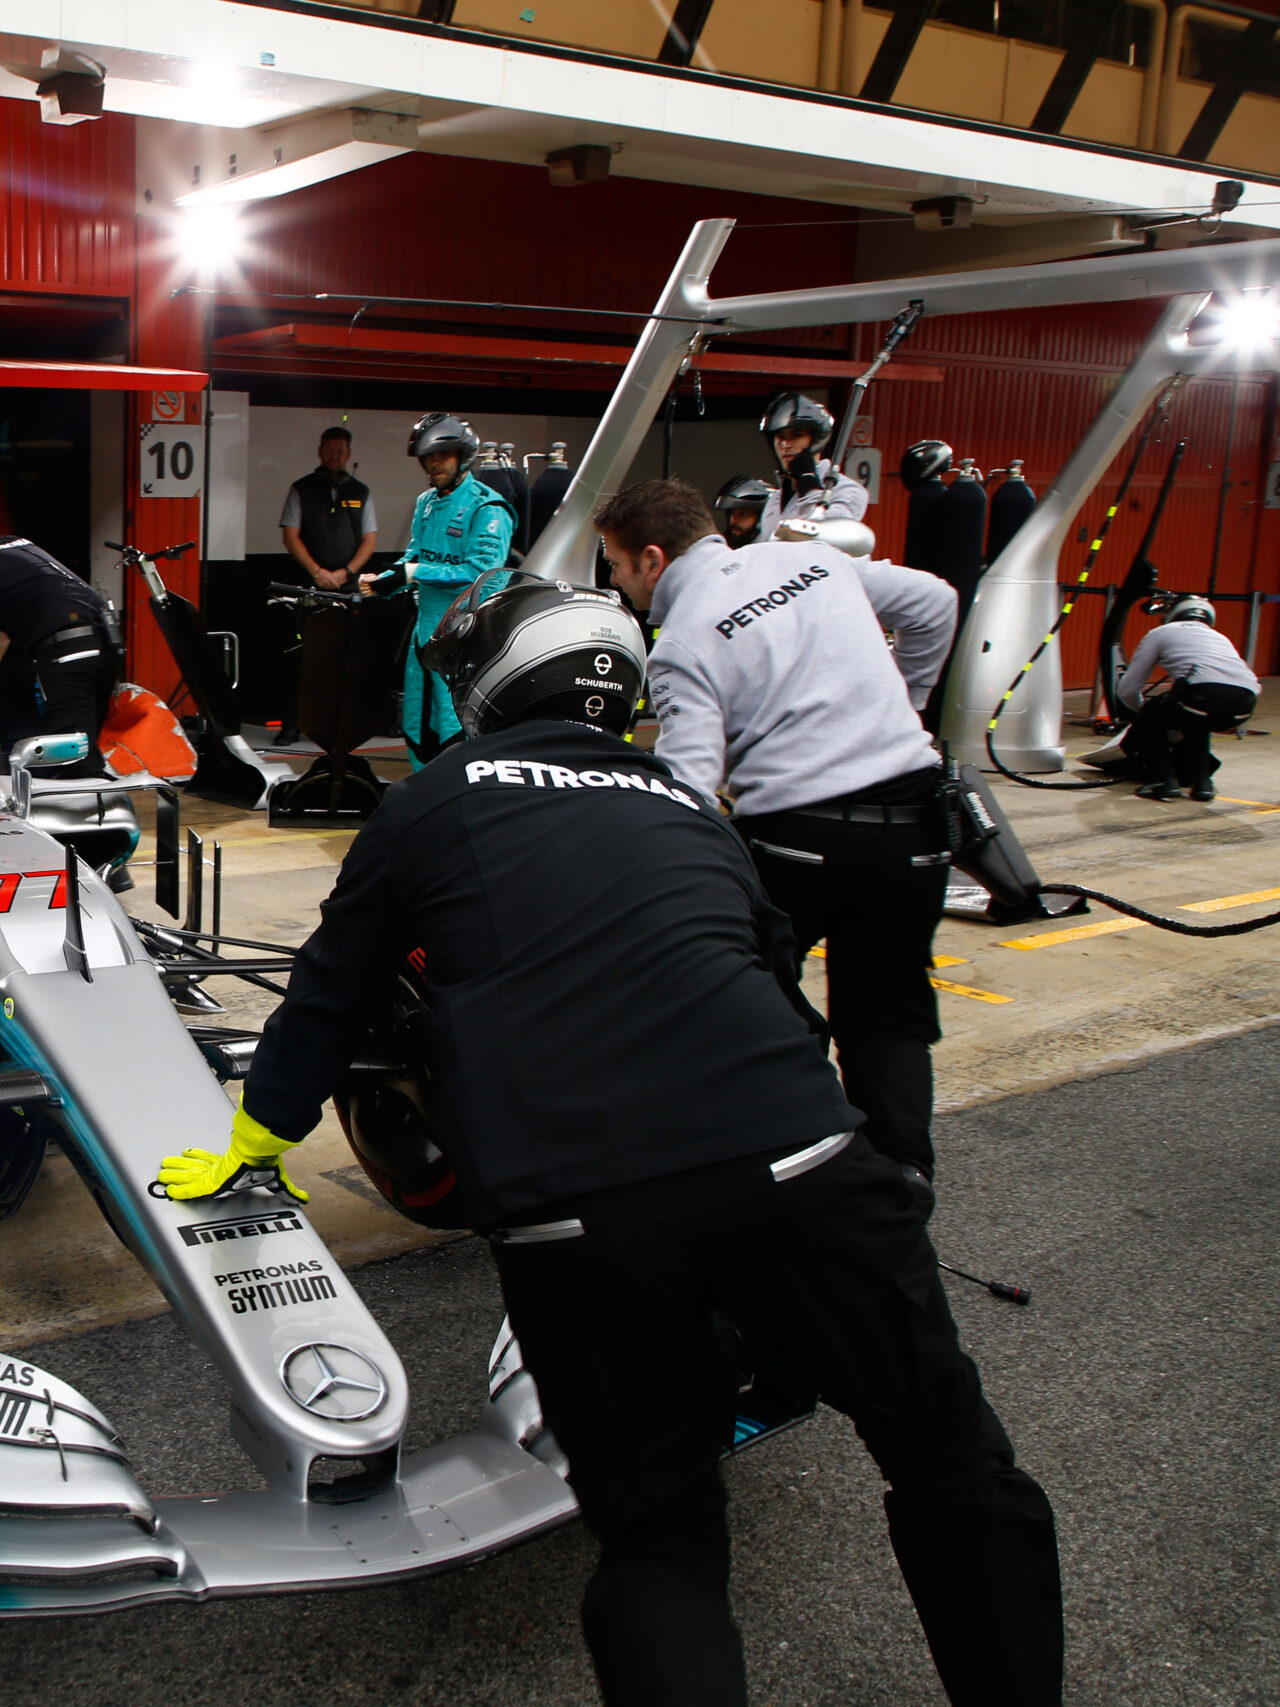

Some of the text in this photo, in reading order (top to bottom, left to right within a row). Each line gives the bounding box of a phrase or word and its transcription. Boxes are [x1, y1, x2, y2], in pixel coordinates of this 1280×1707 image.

[148, 441, 194, 480] 10
[858, 461, 871, 488] 9
[716, 565, 830, 640] PETRONAS
[575, 677, 623, 691] SCHUBERTH
[465, 760, 700, 811] PETRONAS
[177, 1210, 304, 1247] PIRELLI
[214, 1260, 323, 1287] PETRONAS
[228, 1275, 338, 1314] SYNTIUM
